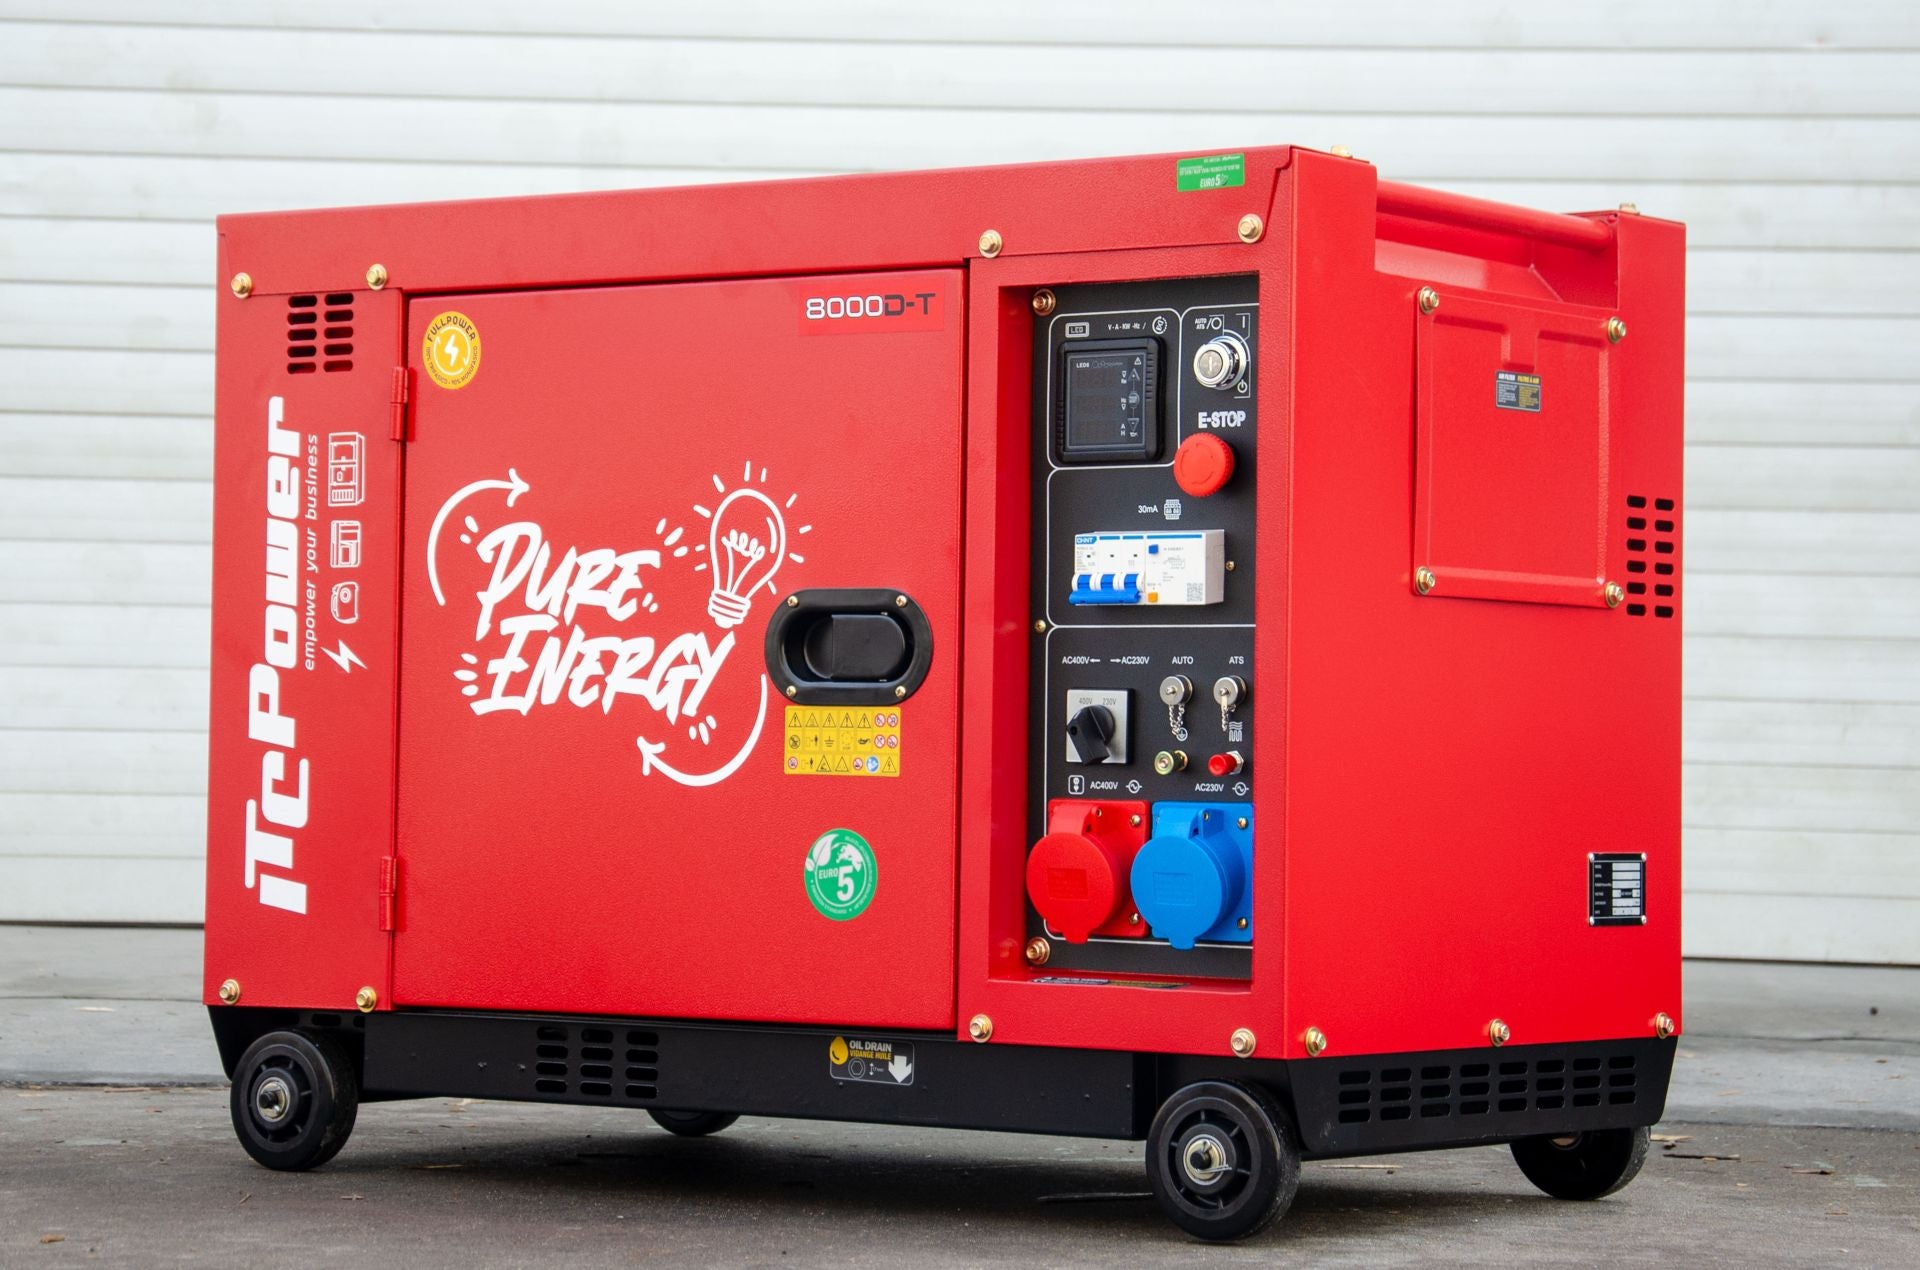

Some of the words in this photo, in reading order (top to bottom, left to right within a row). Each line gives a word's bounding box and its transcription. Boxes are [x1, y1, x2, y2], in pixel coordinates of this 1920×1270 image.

[806, 293, 936, 320] 8000D-T
[427, 315, 477, 343] FULLPOWER
[1198, 410, 1247, 429] E-STOP
[304, 434, 318, 521] business
[1138, 504, 1159, 514] 30mA
[306, 527, 319, 574] your
[475, 521, 661, 641] PURE
[304, 579, 318, 671] empower
[469, 614, 736, 726] ENERGY
[1061, 656, 1090, 665] AC400V
[1121, 656, 1150, 665] AC230V
[1171, 656, 1194, 665] AUTO
[1229, 656, 1245, 665] ATS
[1089, 780, 1119, 790] AC400V
[1194, 783, 1225, 793] AC230V
[836, 864, 855, 902] 5
[849, 1040, 864, 1050] OIL
[864, 1041, 892, 1053] DRAIN
